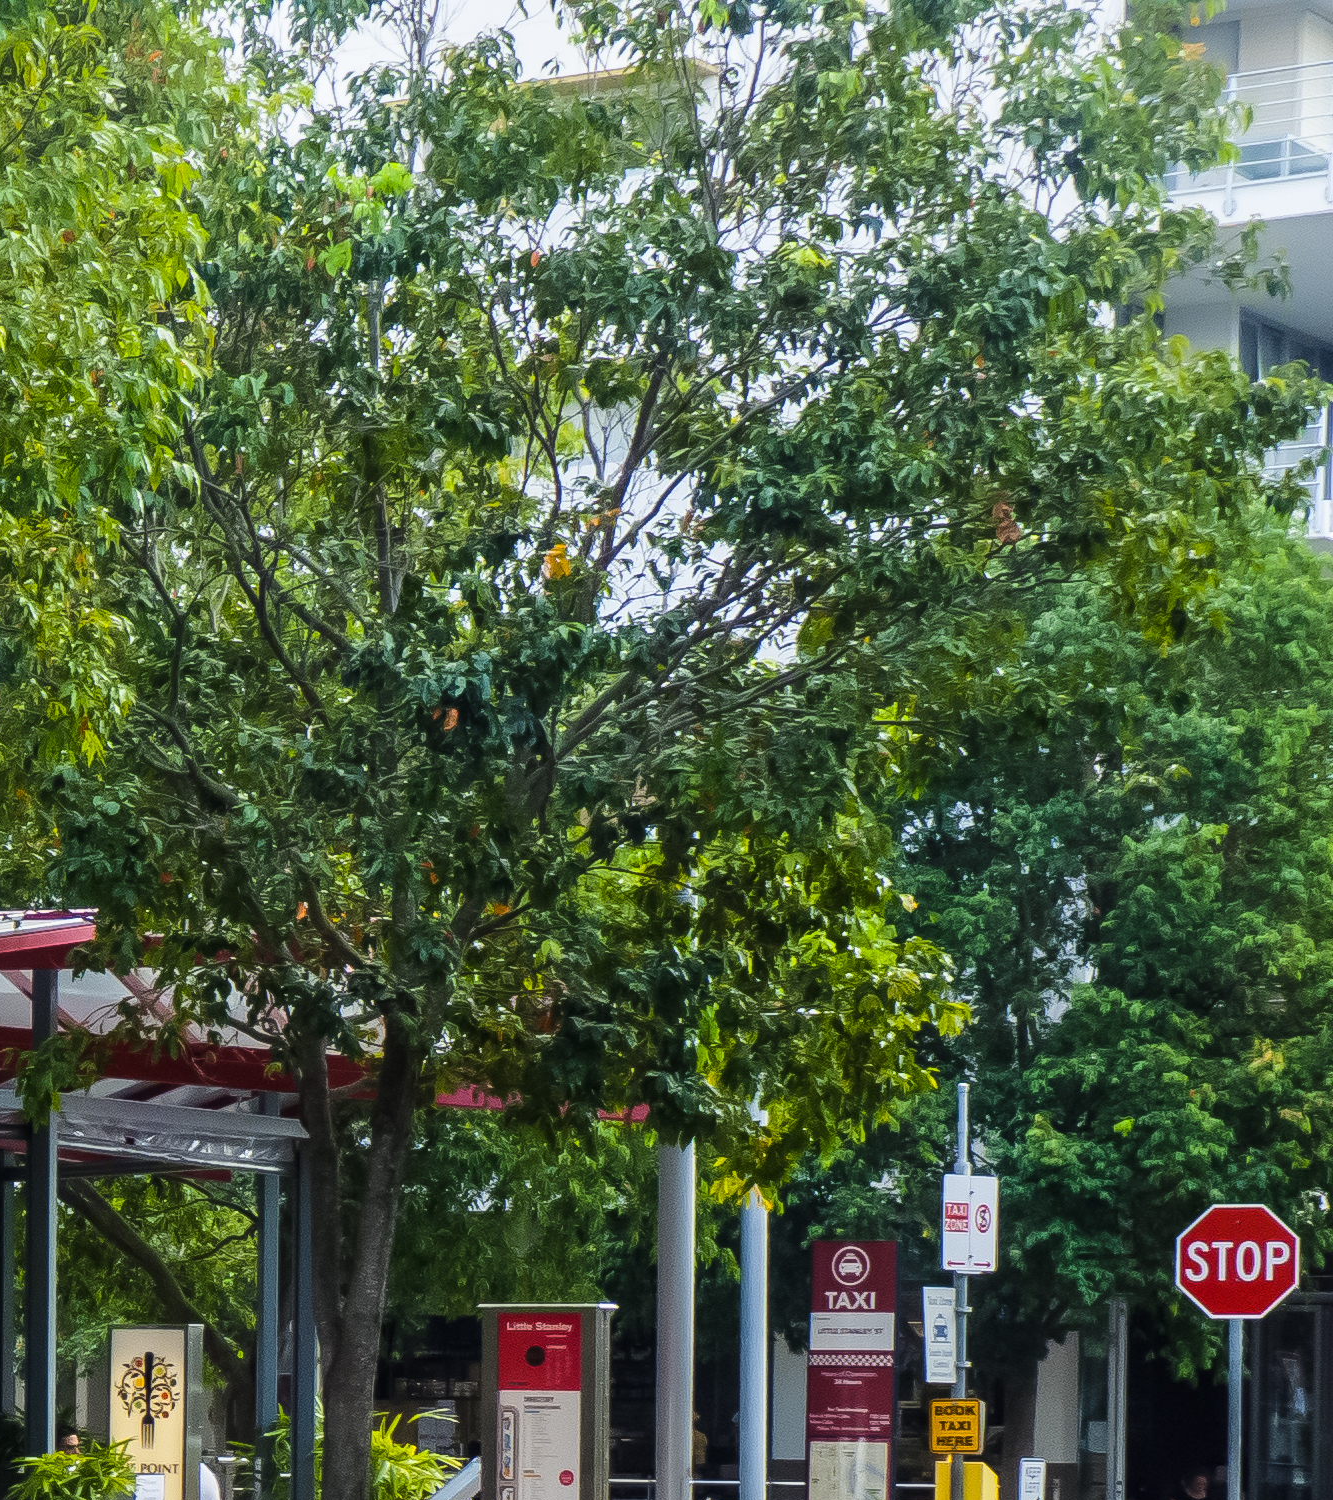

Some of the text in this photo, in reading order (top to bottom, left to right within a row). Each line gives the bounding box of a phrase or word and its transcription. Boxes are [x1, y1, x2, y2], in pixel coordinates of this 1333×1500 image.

[946, 1204, 967, 1216] TAXI
[945, 1219, 968, 1231] ZONE
[1185, 1241, 1290, 1282] STOP
[824, 1291, 877, 1310] TAXI
[934, 1405, 976, 1416] BOOK
[938, 1420, 972, 1431] TAXI
[936, 1435, 974, 1447] HERE
[140, 1463, 180, 1474] POINT
